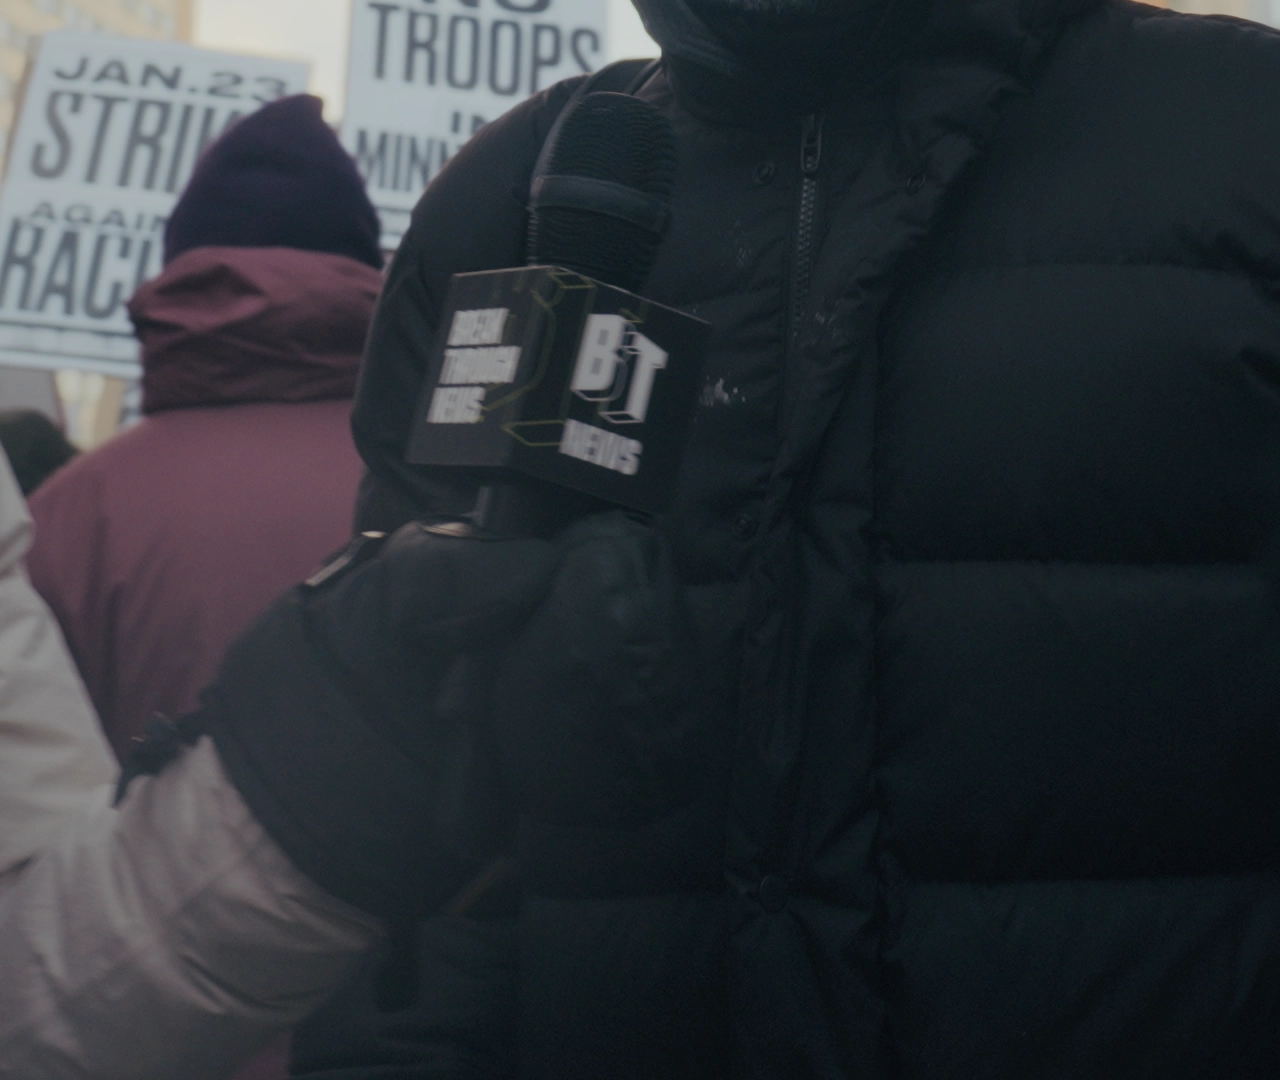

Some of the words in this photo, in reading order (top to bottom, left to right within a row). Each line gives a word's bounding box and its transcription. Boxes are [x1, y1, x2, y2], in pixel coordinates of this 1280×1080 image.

[53, 57, 288, 103] JAN.23
[368, 2, 600, 96] TROOPS
[31, 89, 240, 194] STRI
[560, 419, 642, 475] NEWS
